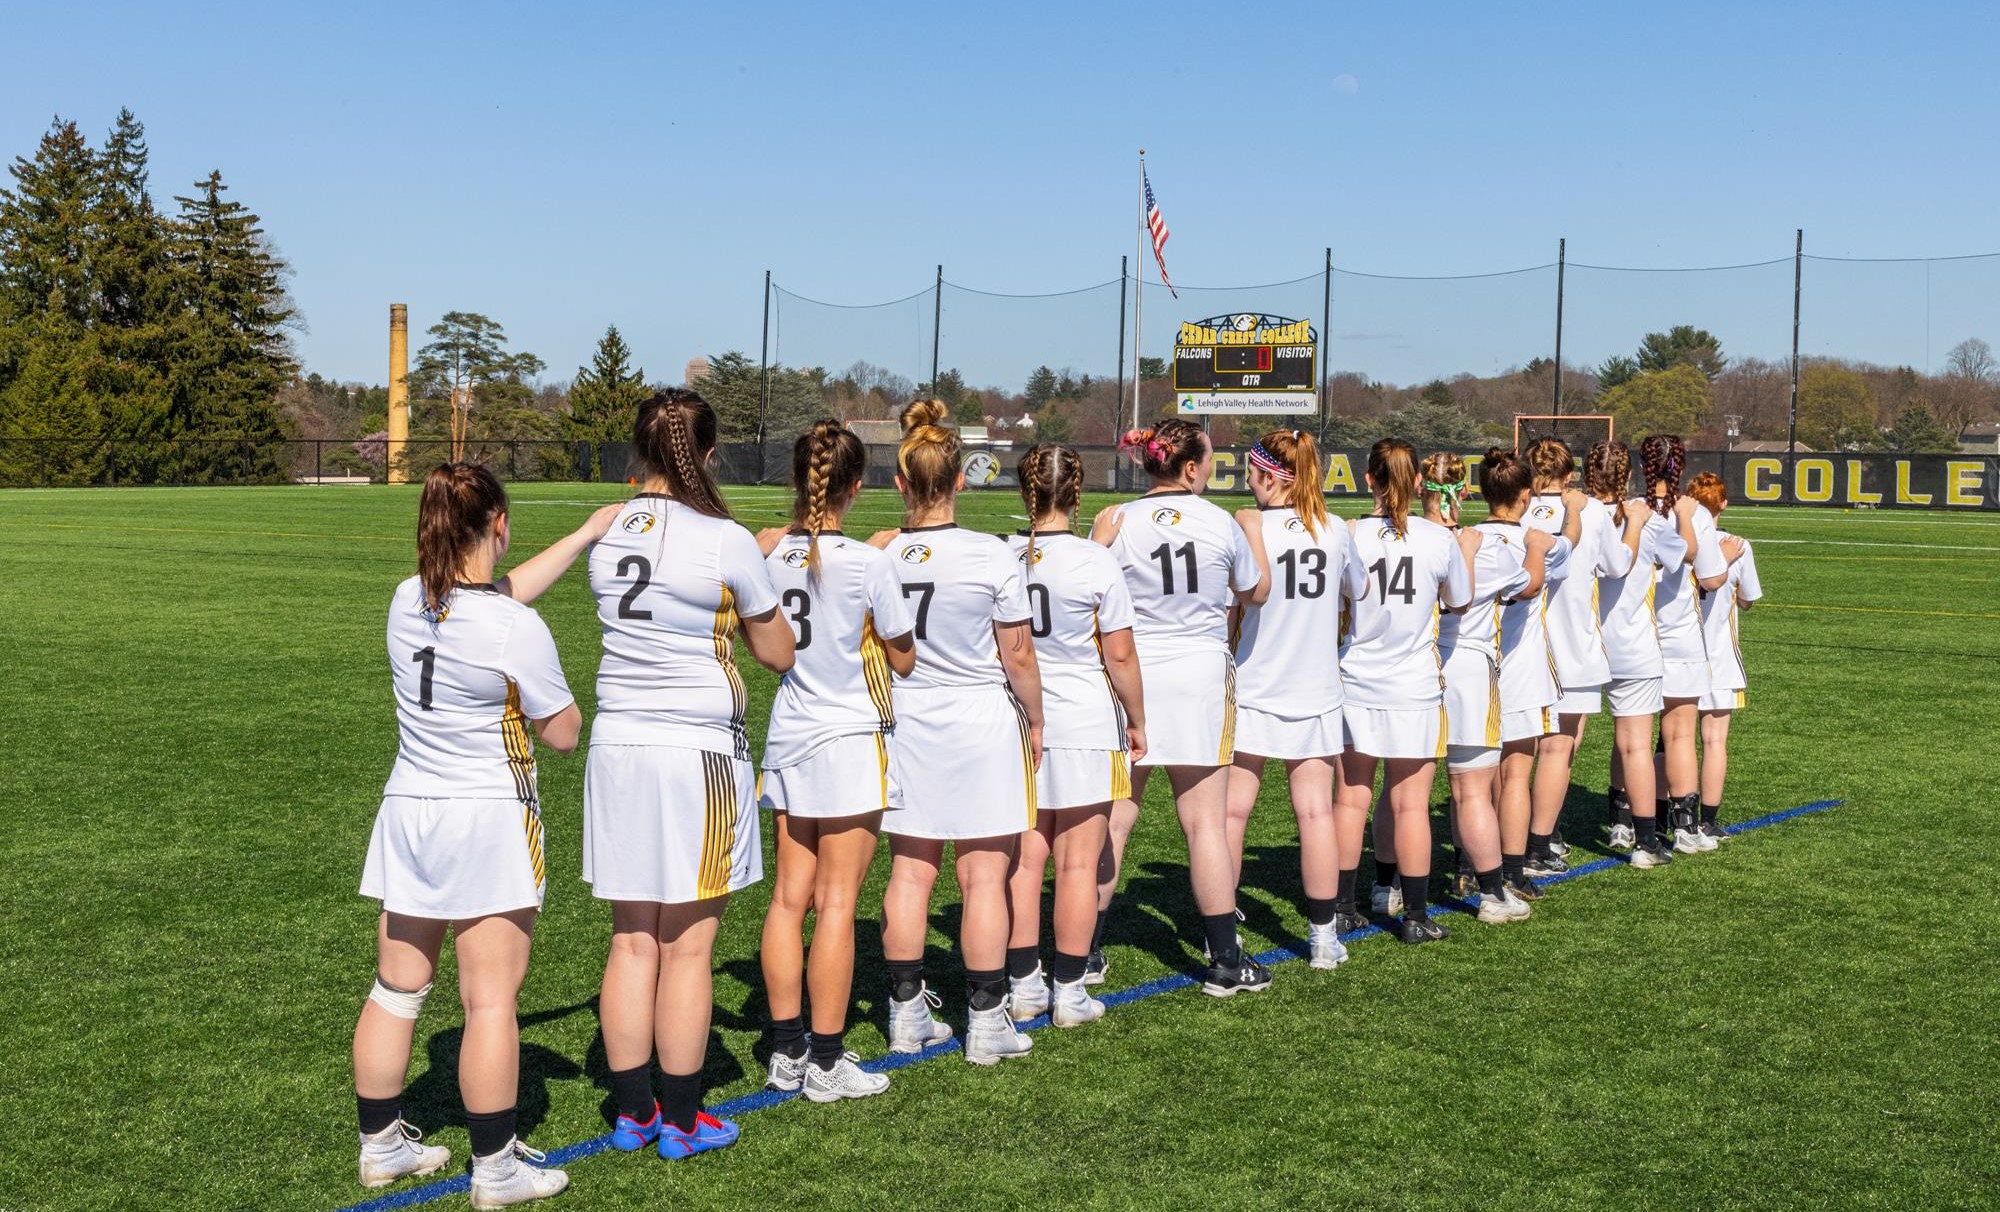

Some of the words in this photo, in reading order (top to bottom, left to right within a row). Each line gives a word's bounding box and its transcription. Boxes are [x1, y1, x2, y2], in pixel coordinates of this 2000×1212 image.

[1176, 348, 1212, 359] FALCONS
[1181, 321, 1217, 345] CEDAR
[1221, 330, 1256, 345] CREST
[1260, 319, 1309, 344] COLLEGE
[1276, 346, 1313, 359] VISITOR
[1198, 399, 1223, 409] Lehigh
[1224, 399, 1246, 409] Valley
[1248, 399, 1274, 407] Health
[1275, 399, 1309, 407] Network
[1242, 374, 1260, 386] QTR
[1745, 458, 2000, 506] COLLE
[616, 555, 653, 620] 2
[1150, 541, 1199, 596] 11
[1277, 548, 1328, 600] 13
[1369, 556, 1417, 605] 14
[782, 588, 812, 651] 3
[901, 581, 935, 640] 7
[412, 646, 436, 711] 1
